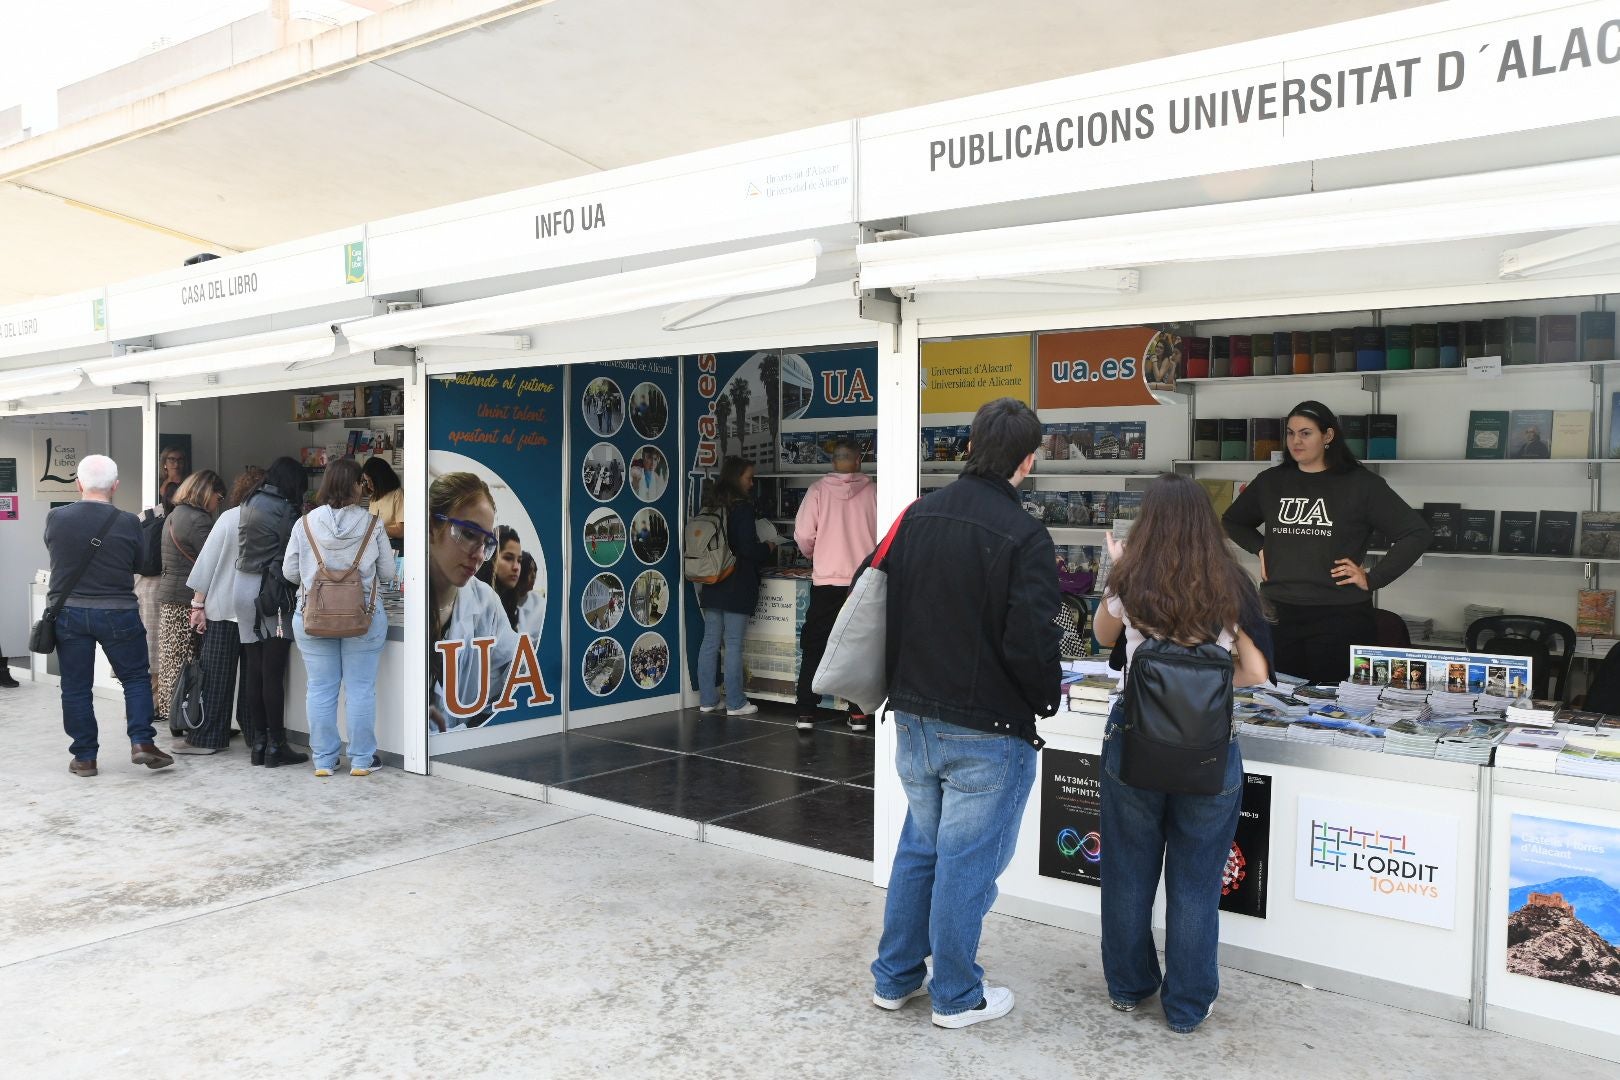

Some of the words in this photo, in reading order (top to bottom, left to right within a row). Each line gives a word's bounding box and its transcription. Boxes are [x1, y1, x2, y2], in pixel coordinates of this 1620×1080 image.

[930, 103, 1154, 172] PUBLICACIONS
[1168, 56, 1422, 135] UNIVERSITAT
[535, 208, 574, 240] INFO
[581, 203, 606, 231] UA
[181, 284, 206, 305] CASA
[208, 279, 226, 300] DEL
[228, 272, 258, 296] LIBRO
[4, 322, 16, 338] DEL
[18, 318, 38, 336] LIBRO
[639, 360, 647, 371] de
[647, 361, 673, 374] Alicante
[931, 365, 972, 377] Universitat
[974, 362, 1013, 374] d'Alacant
[1052, 357, 1137, 383] ua.es
[503, 373, 516, 390] al
[517, 377, 555, 397] futuro
[821, 367, 874, 405] UA
[931, 377, 976, 390] Universidad
[977, 377, 987, 388] de
[989, 376, 1022, 387] Alicante
[698, 354, 717, 467] ua.es
[54, 445, 76, 453] Casa
[448, 428, 500, 446] apostant
[502, 427, 516, 445] al
[517, 431, 550, 451] futur
[54, 459, 76, 467] Libro
[1278, 497, 1333, 527] UA
[1272, 527, 1332, 537] PUBLICACIONS
[435, 632, 555, 718] UA
[1521, 843, 1572, 860] d'Alacant
[1353, 852, 1438, 883] L'ORDIT
